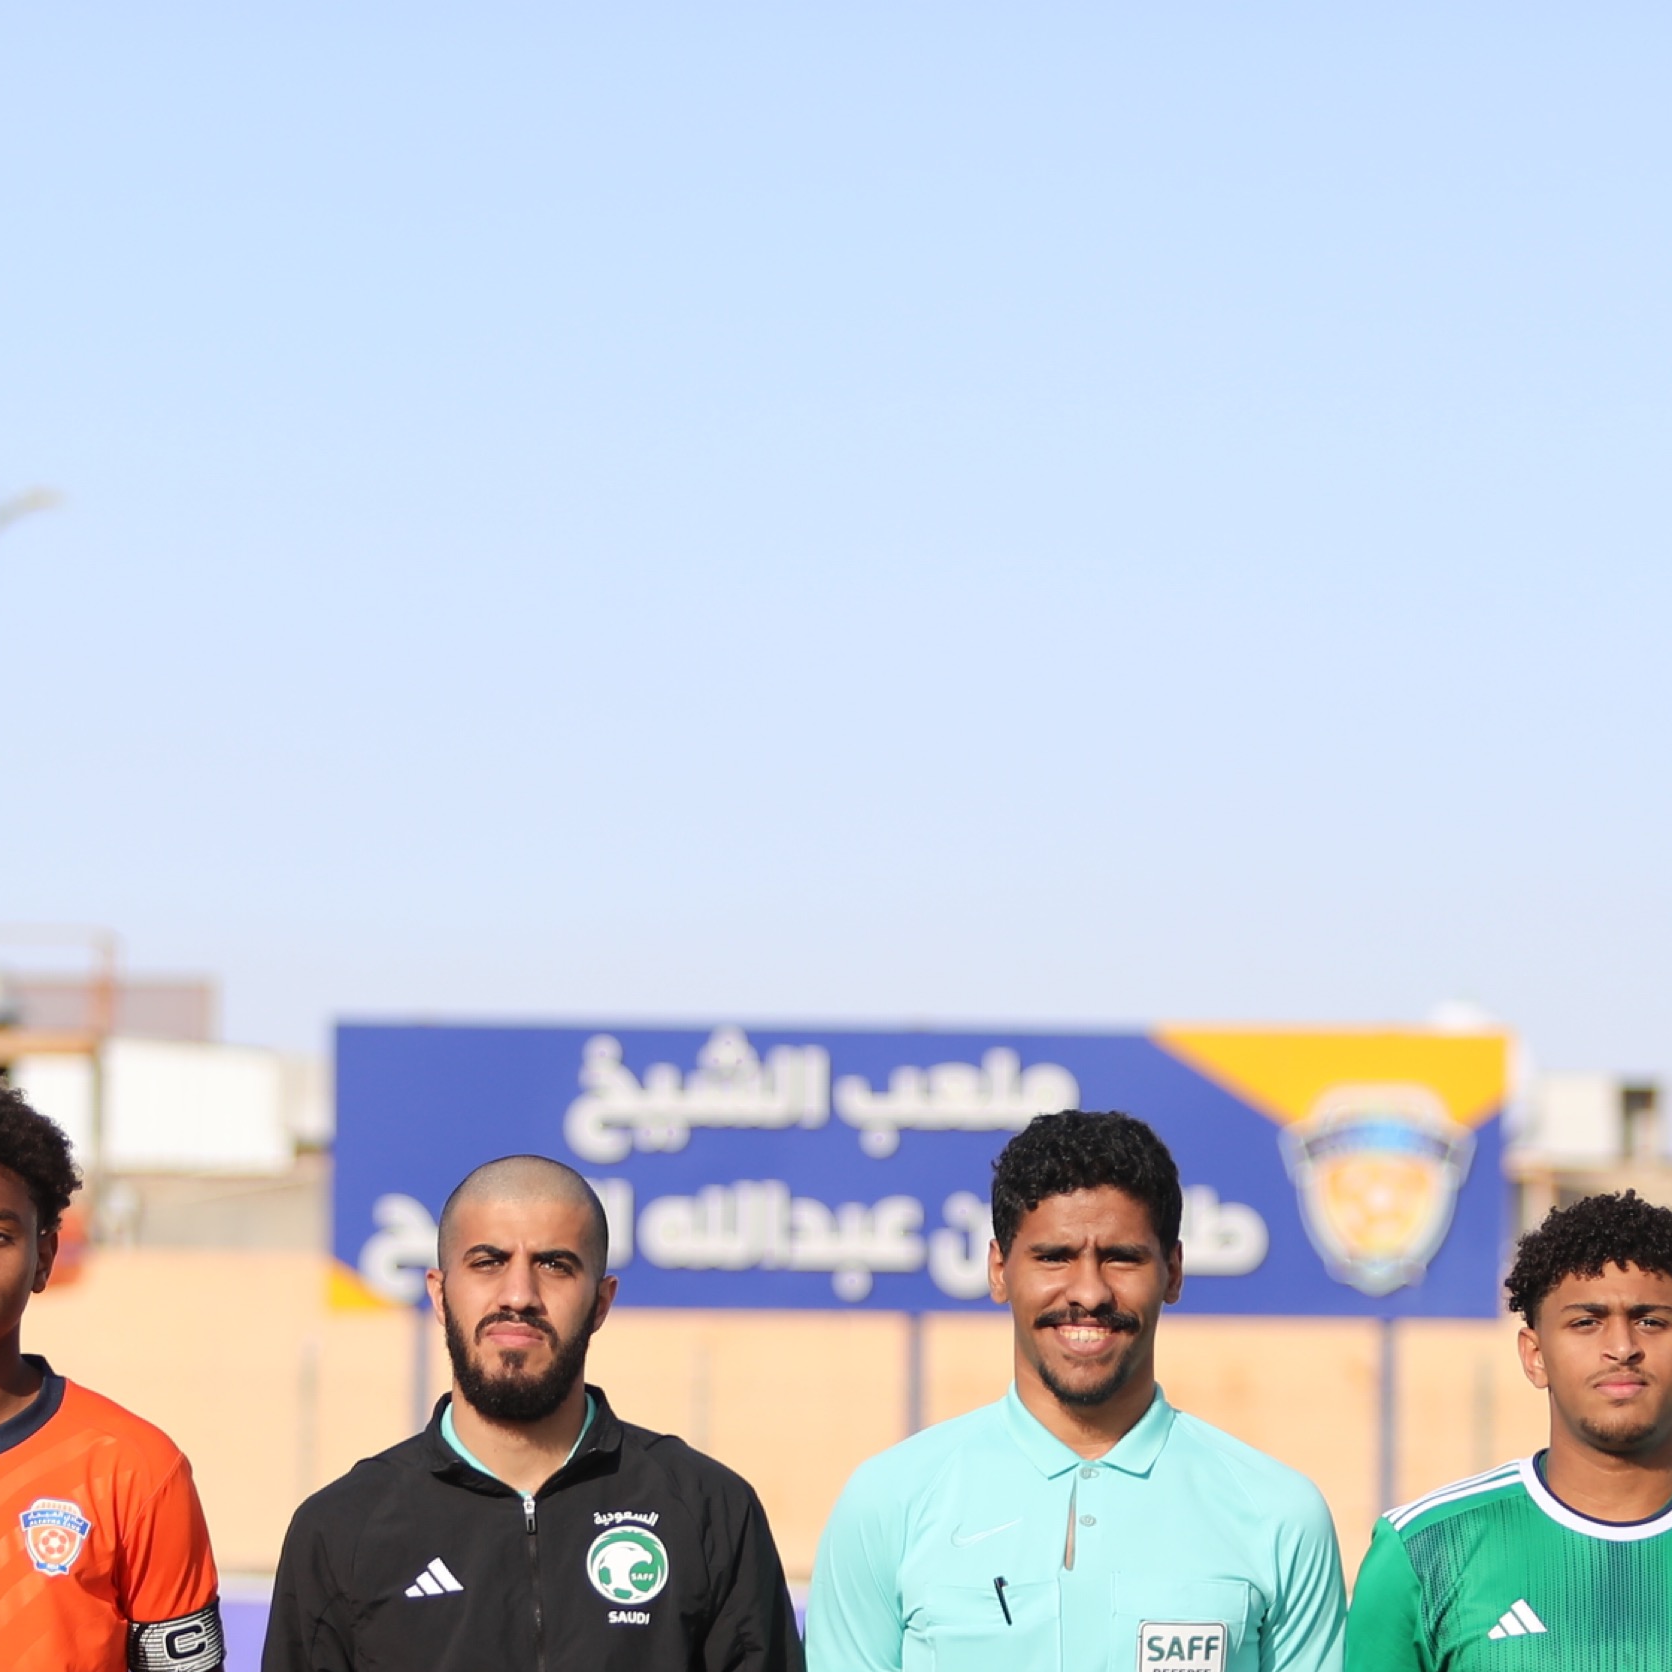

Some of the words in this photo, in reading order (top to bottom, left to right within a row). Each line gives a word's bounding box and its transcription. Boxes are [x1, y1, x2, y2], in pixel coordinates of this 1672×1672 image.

[564, 1025, 829, 1163] الشيخ
[833, 1047, 1080, 1159] ملعب
[636, 1178, 927, 1300] عبدالله
[593, 1510, 659, 1527] السعودية
[631, 1572, 654, 1581] SAFF
[608, 1610, 650, 1625] SAUDI
[165, 1622, 207, 1661] C
[1147, 1635, 1221, 1662] SAFF
